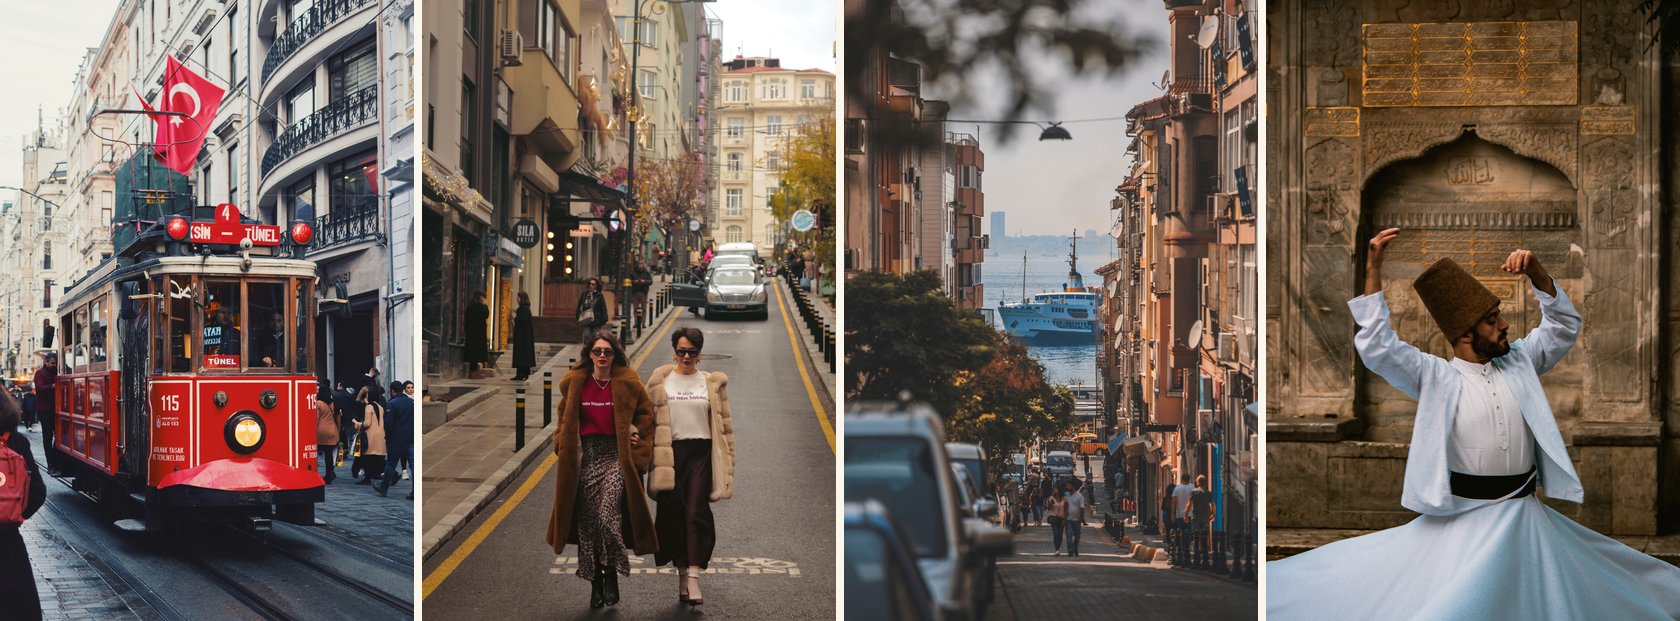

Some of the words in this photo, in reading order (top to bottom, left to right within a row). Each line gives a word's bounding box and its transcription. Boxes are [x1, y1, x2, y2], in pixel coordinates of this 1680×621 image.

[222, 204, 230, 221] 4
[245, 226, 279, 243] TÜNEL
[517, 225, 534, 237] SILA
[208, 356, 237, 365] TÜNEL
[161, 395, 180, 411] 115
